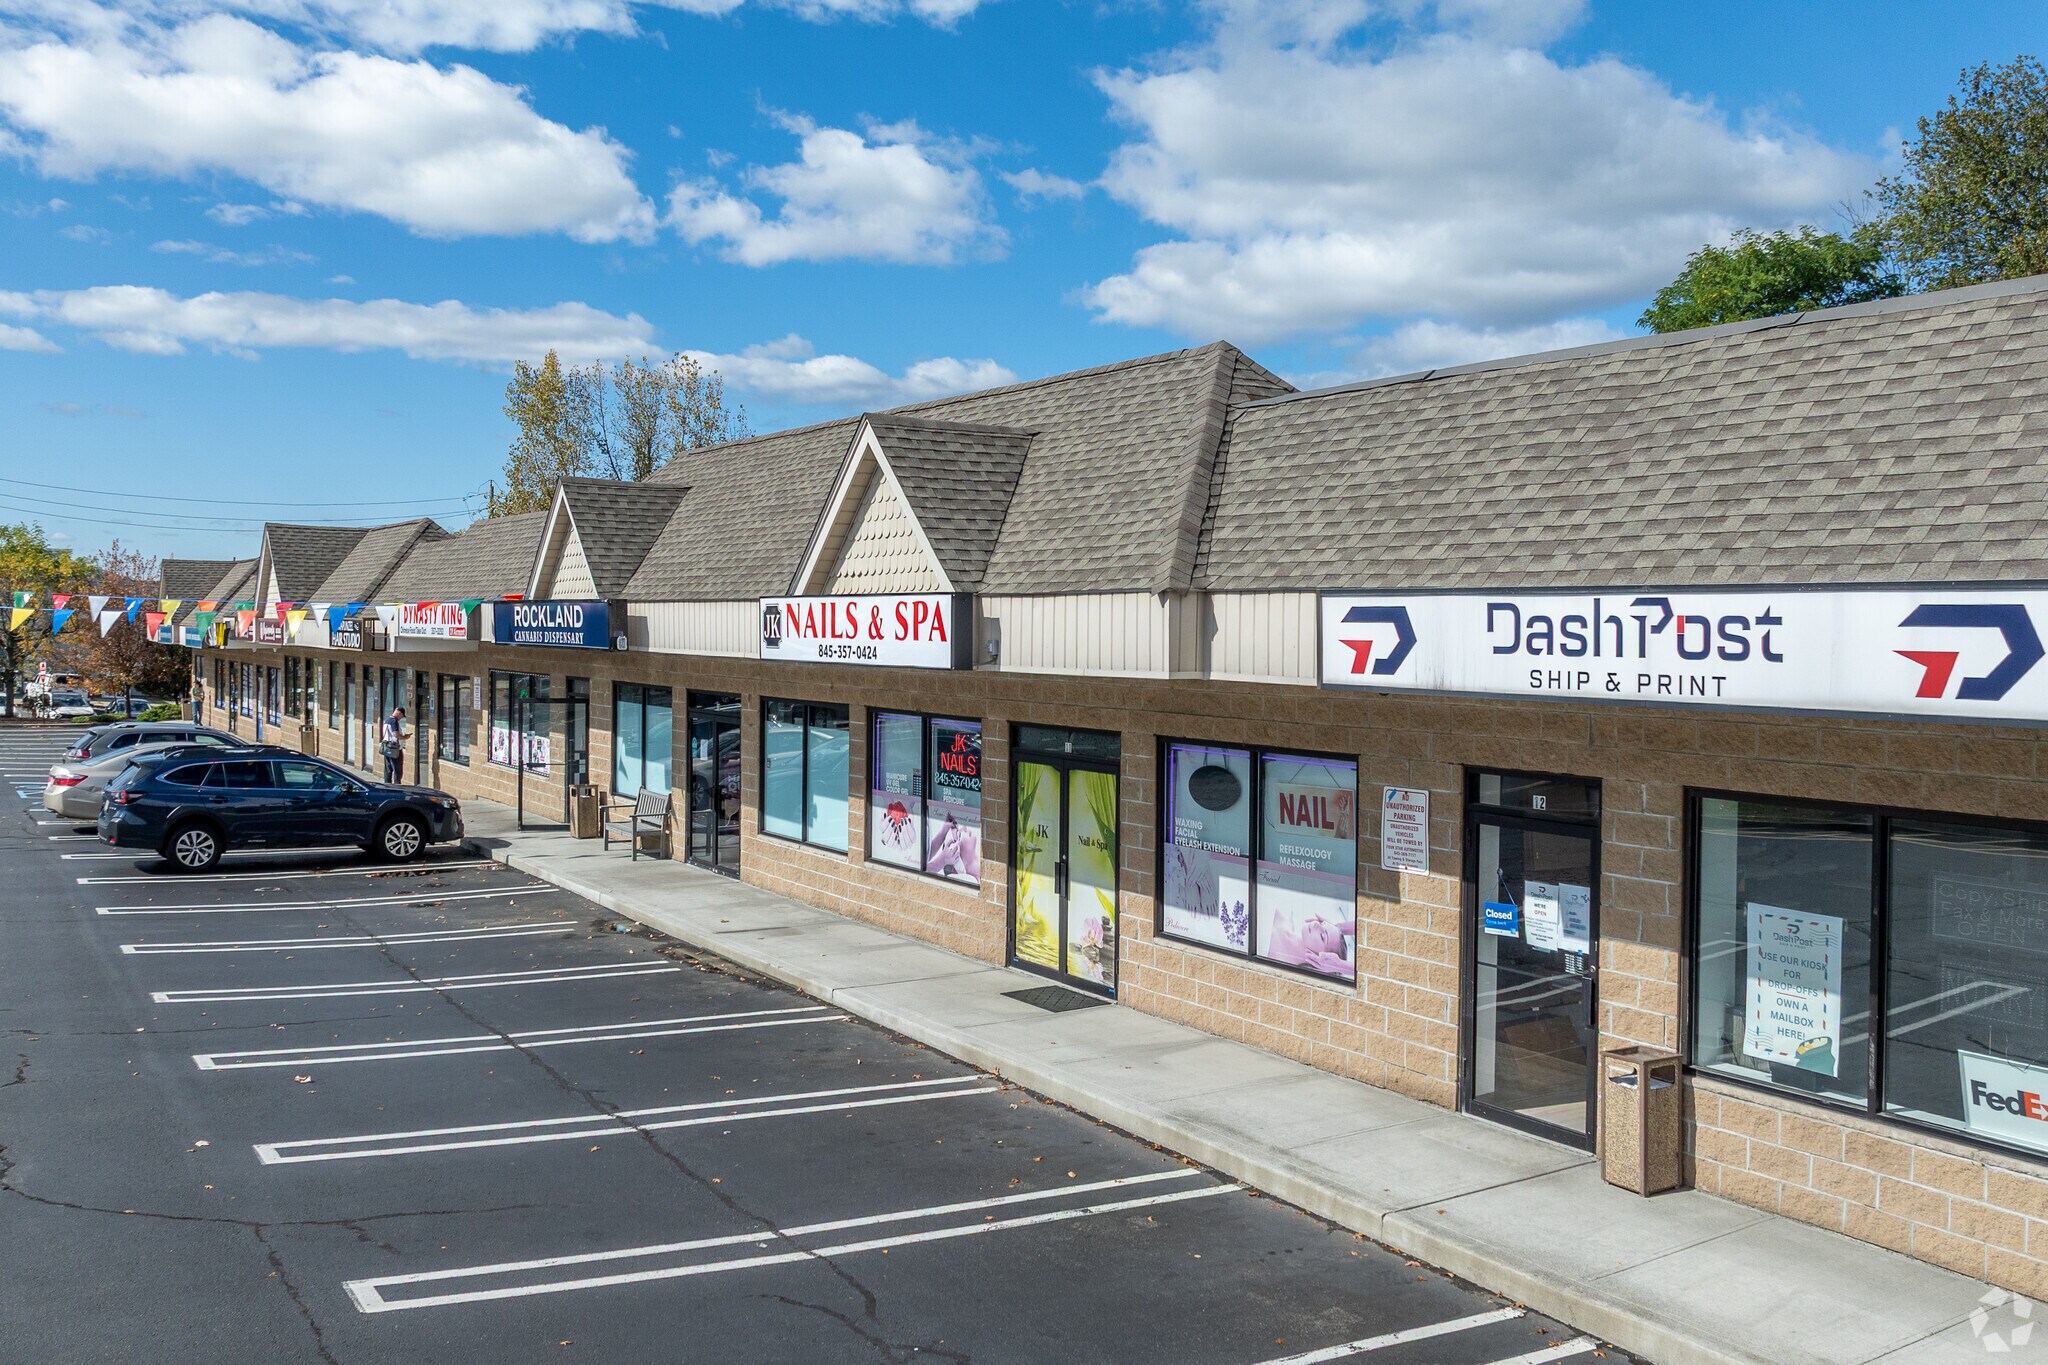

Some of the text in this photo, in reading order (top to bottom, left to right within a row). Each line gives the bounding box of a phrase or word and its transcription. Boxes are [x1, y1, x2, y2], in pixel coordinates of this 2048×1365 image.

[403, 605, 463, 625] DYNASTY KING
[514, 605, 584, 628] ROCKLAND
[786, 600, 948, 642] NAILS & SPA
[764, 614, 781, 639] JK
[1487, 597, 1784, 663] DashPost
[514, 630, 584, 645] CANNABIS DISPENSARY
[818, 644, 878, 660] 845-357-0424
[1529, 669, 1727, 697] SHIP & PRINT
[951, 733, 966, 752] JK
[940, 752, 977, 775] NAILS
[942, 787, 952, 796] SPA
[942, 796, 965, 805] PEDICURE
[1386, 802, 1424, 813] UNAUTHORIZED
[1279, 792, 1335, 831] NAIL
[1393, 812, 1416, 821] PARKING
[1036, 824, 1049, 839] JK
[1175, 817, 1203, 830] WAXING
[1175, 828, 1199, 839] FACIAL
[1078, 835, 1090, 847] Nail
[1096, 838, 1108, 852] Spa
[1174, 838, 1241, 856] EYELASH EXTENSION
[1279, 844, 1332, 861] REFLEXOLOGY
[1279, 856, 1316, 871] MASSAGE
[1485, 908, 1512, 920] Closed
[1940, 901, 1974, 920] Fax
[1773, 932, 1814, 947] DashPost
[1957, 921, 2026, 945] OPEN
[1761, 952, 1828, 972] USE OUR KIOSK
[1783, 969, 1801, 980] FOR
[1768, 980, 1819, 997] DROP-OFFS
[1776, 998, 1809, 1012] OWN A
[1770, 1011, 1814, 1028] MAILBOX
[1777, 1027, 1806, 1041] HERE!
